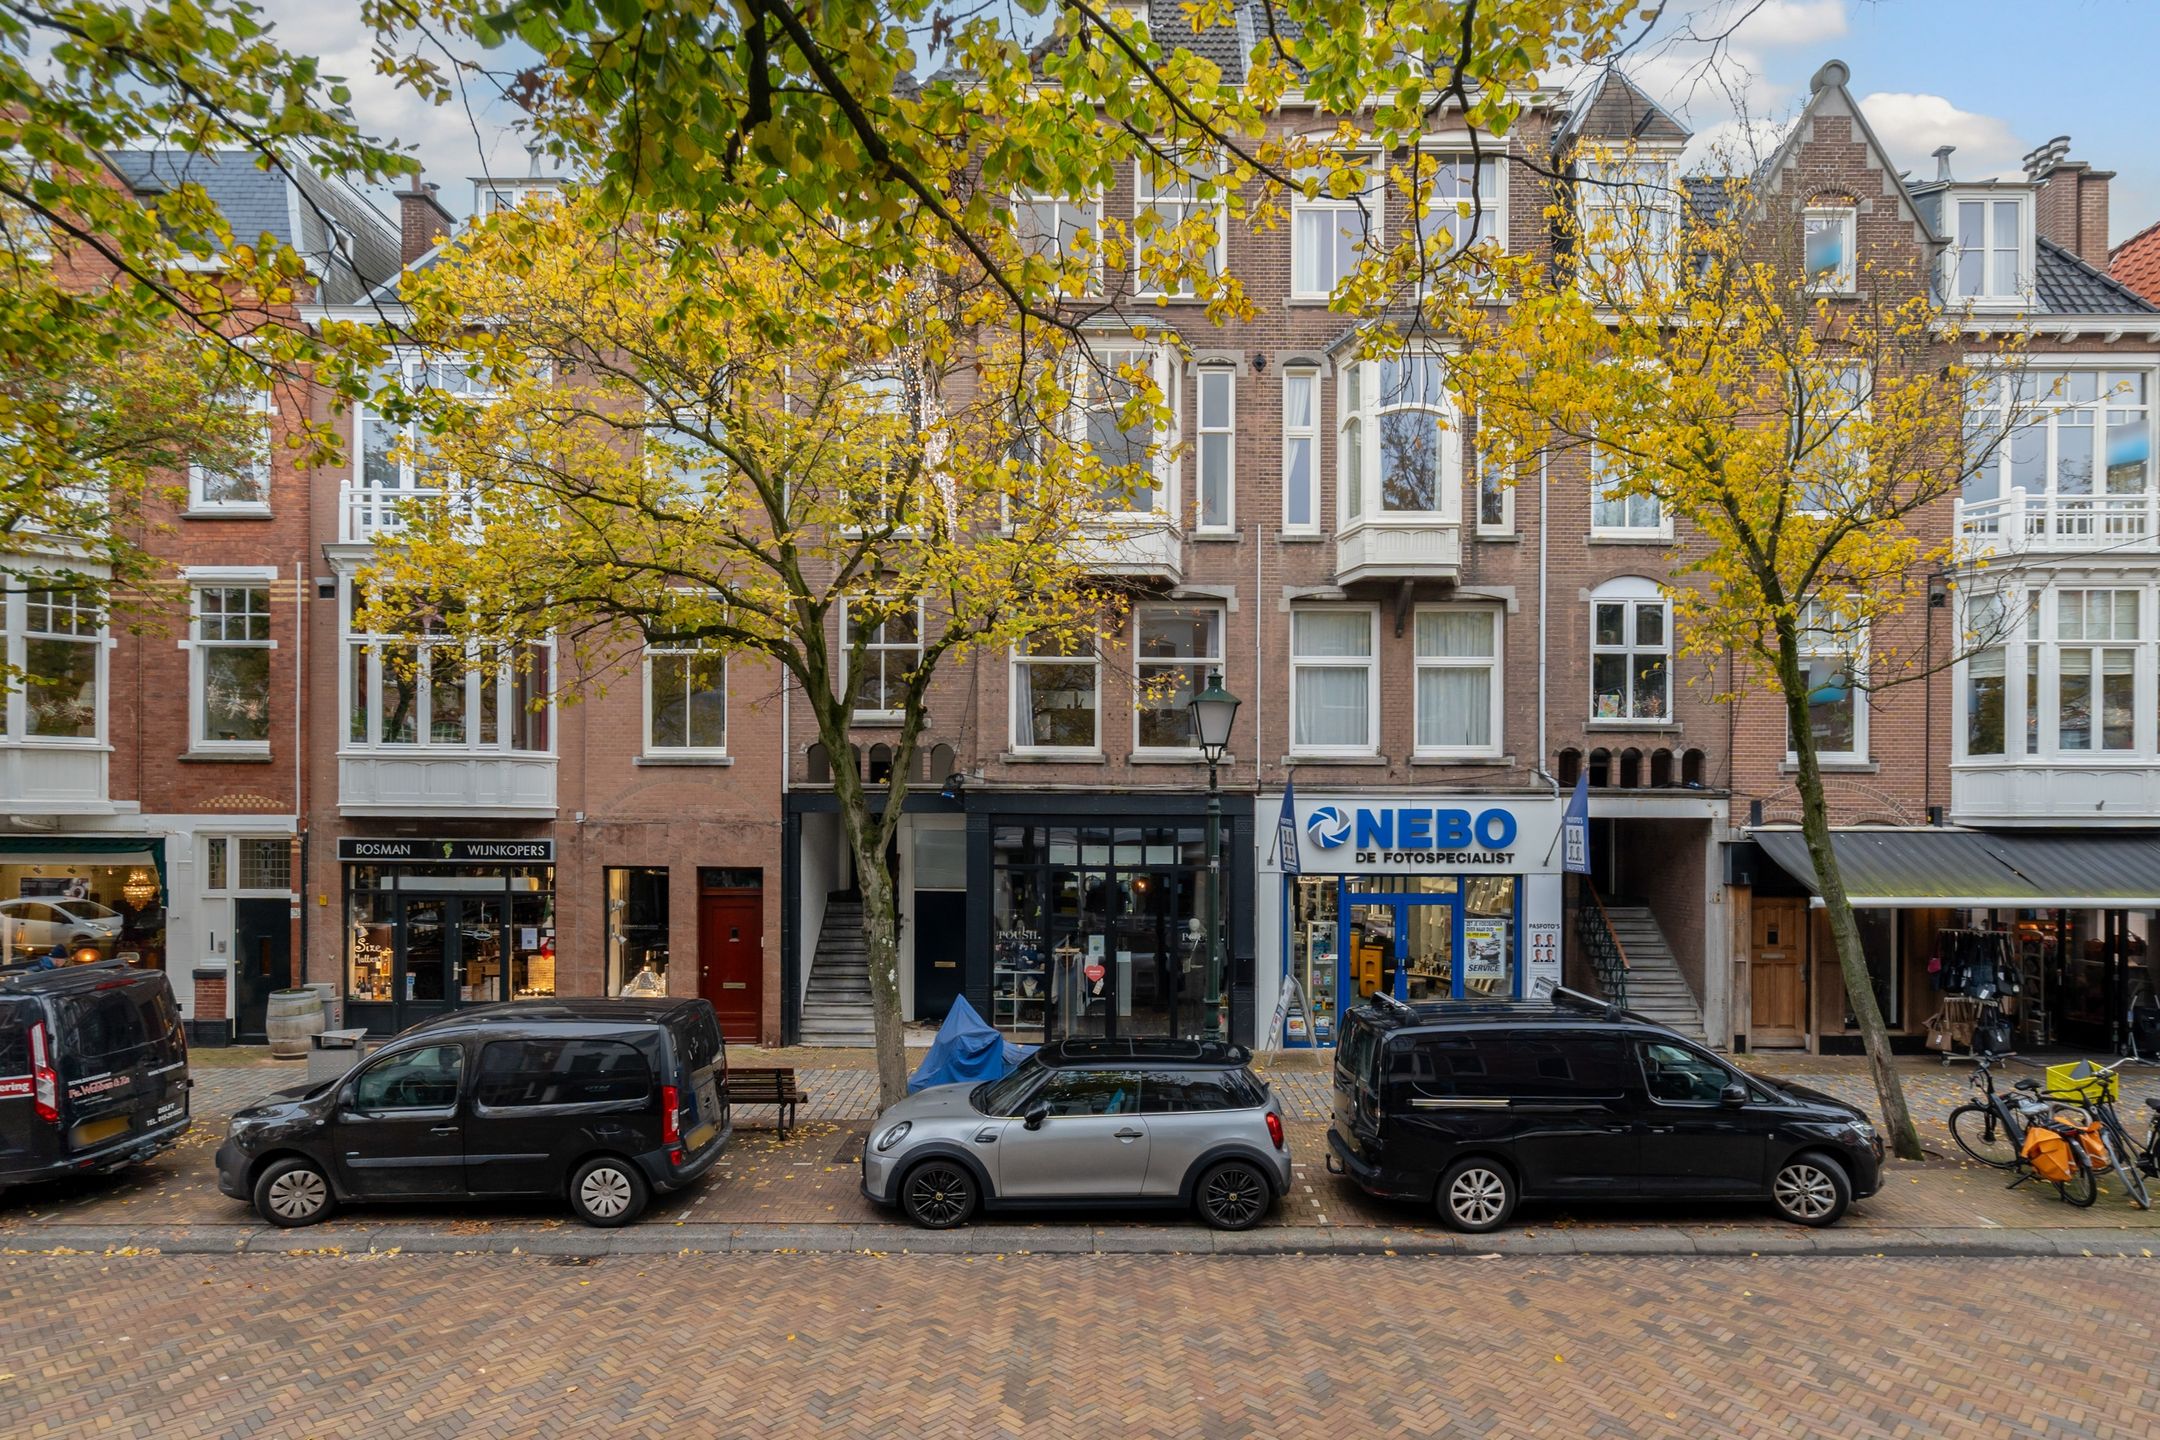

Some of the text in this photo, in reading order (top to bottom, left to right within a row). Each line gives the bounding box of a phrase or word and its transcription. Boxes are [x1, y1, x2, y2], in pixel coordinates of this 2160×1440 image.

[1356, 808, 1518, 850] NEBO
[356, 844, 545, 856] BOSMAN WIJNKOPERS
[1355, 852, 1515, 864] DE FOTOSPECIALIST
[355, 937, 382, 953] Size
[157, 1102, 175, 1114] DELFT
